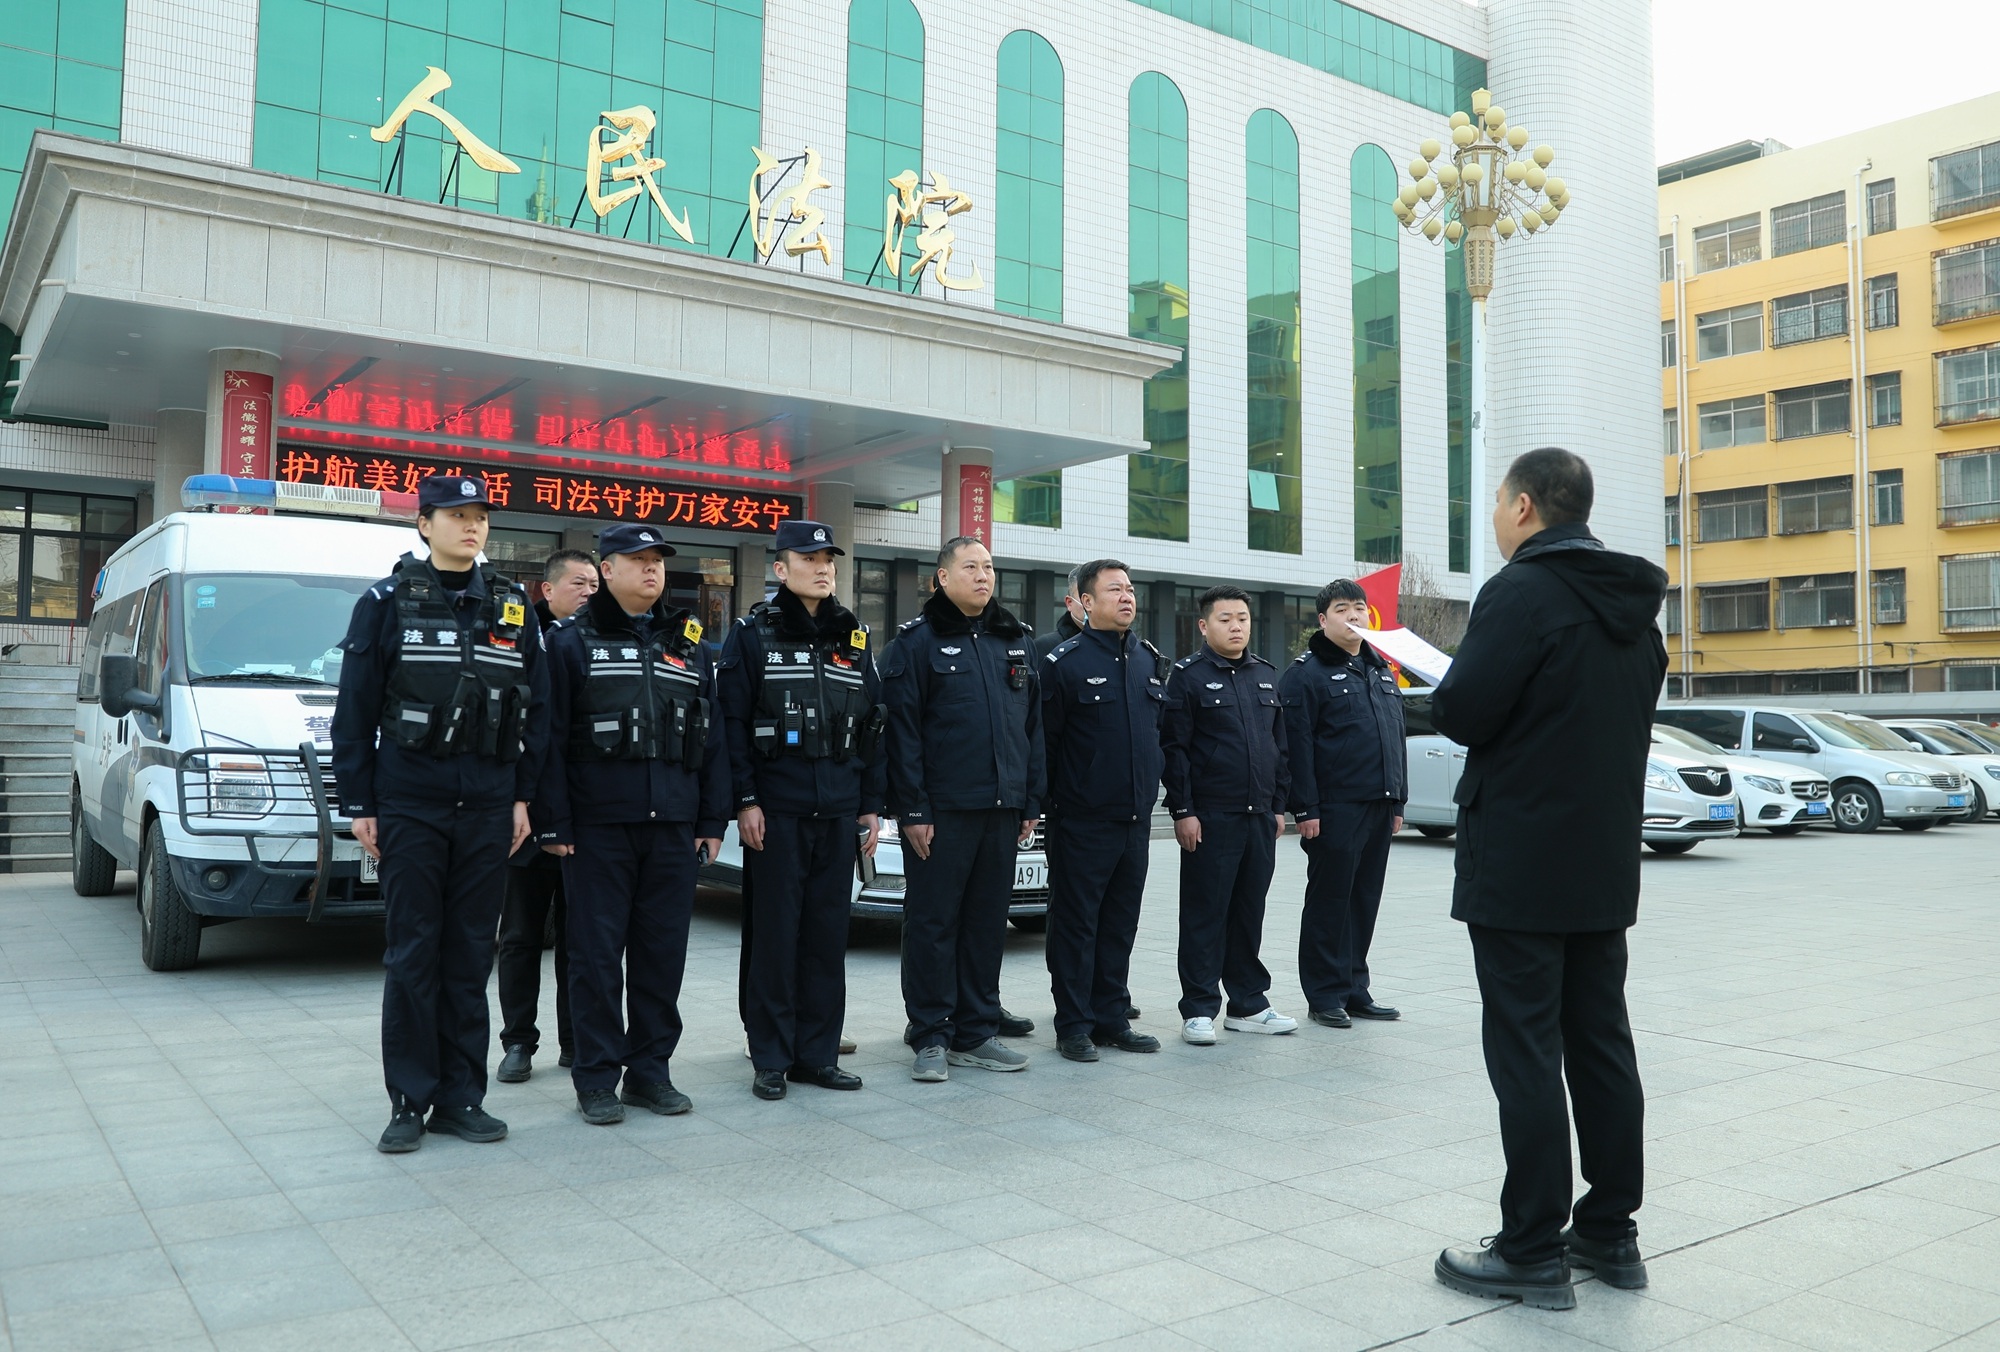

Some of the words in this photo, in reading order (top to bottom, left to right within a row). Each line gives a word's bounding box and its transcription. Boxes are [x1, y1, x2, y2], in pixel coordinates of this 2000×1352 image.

[370, 65, 985, 291] 人民法院
[533, 476, 790, 531] 司法守护万家安宁
[403, 629, 458, 645] 法警
[592, 648, 639, 660] 法警
[767, 651, 811, 664] 法警
